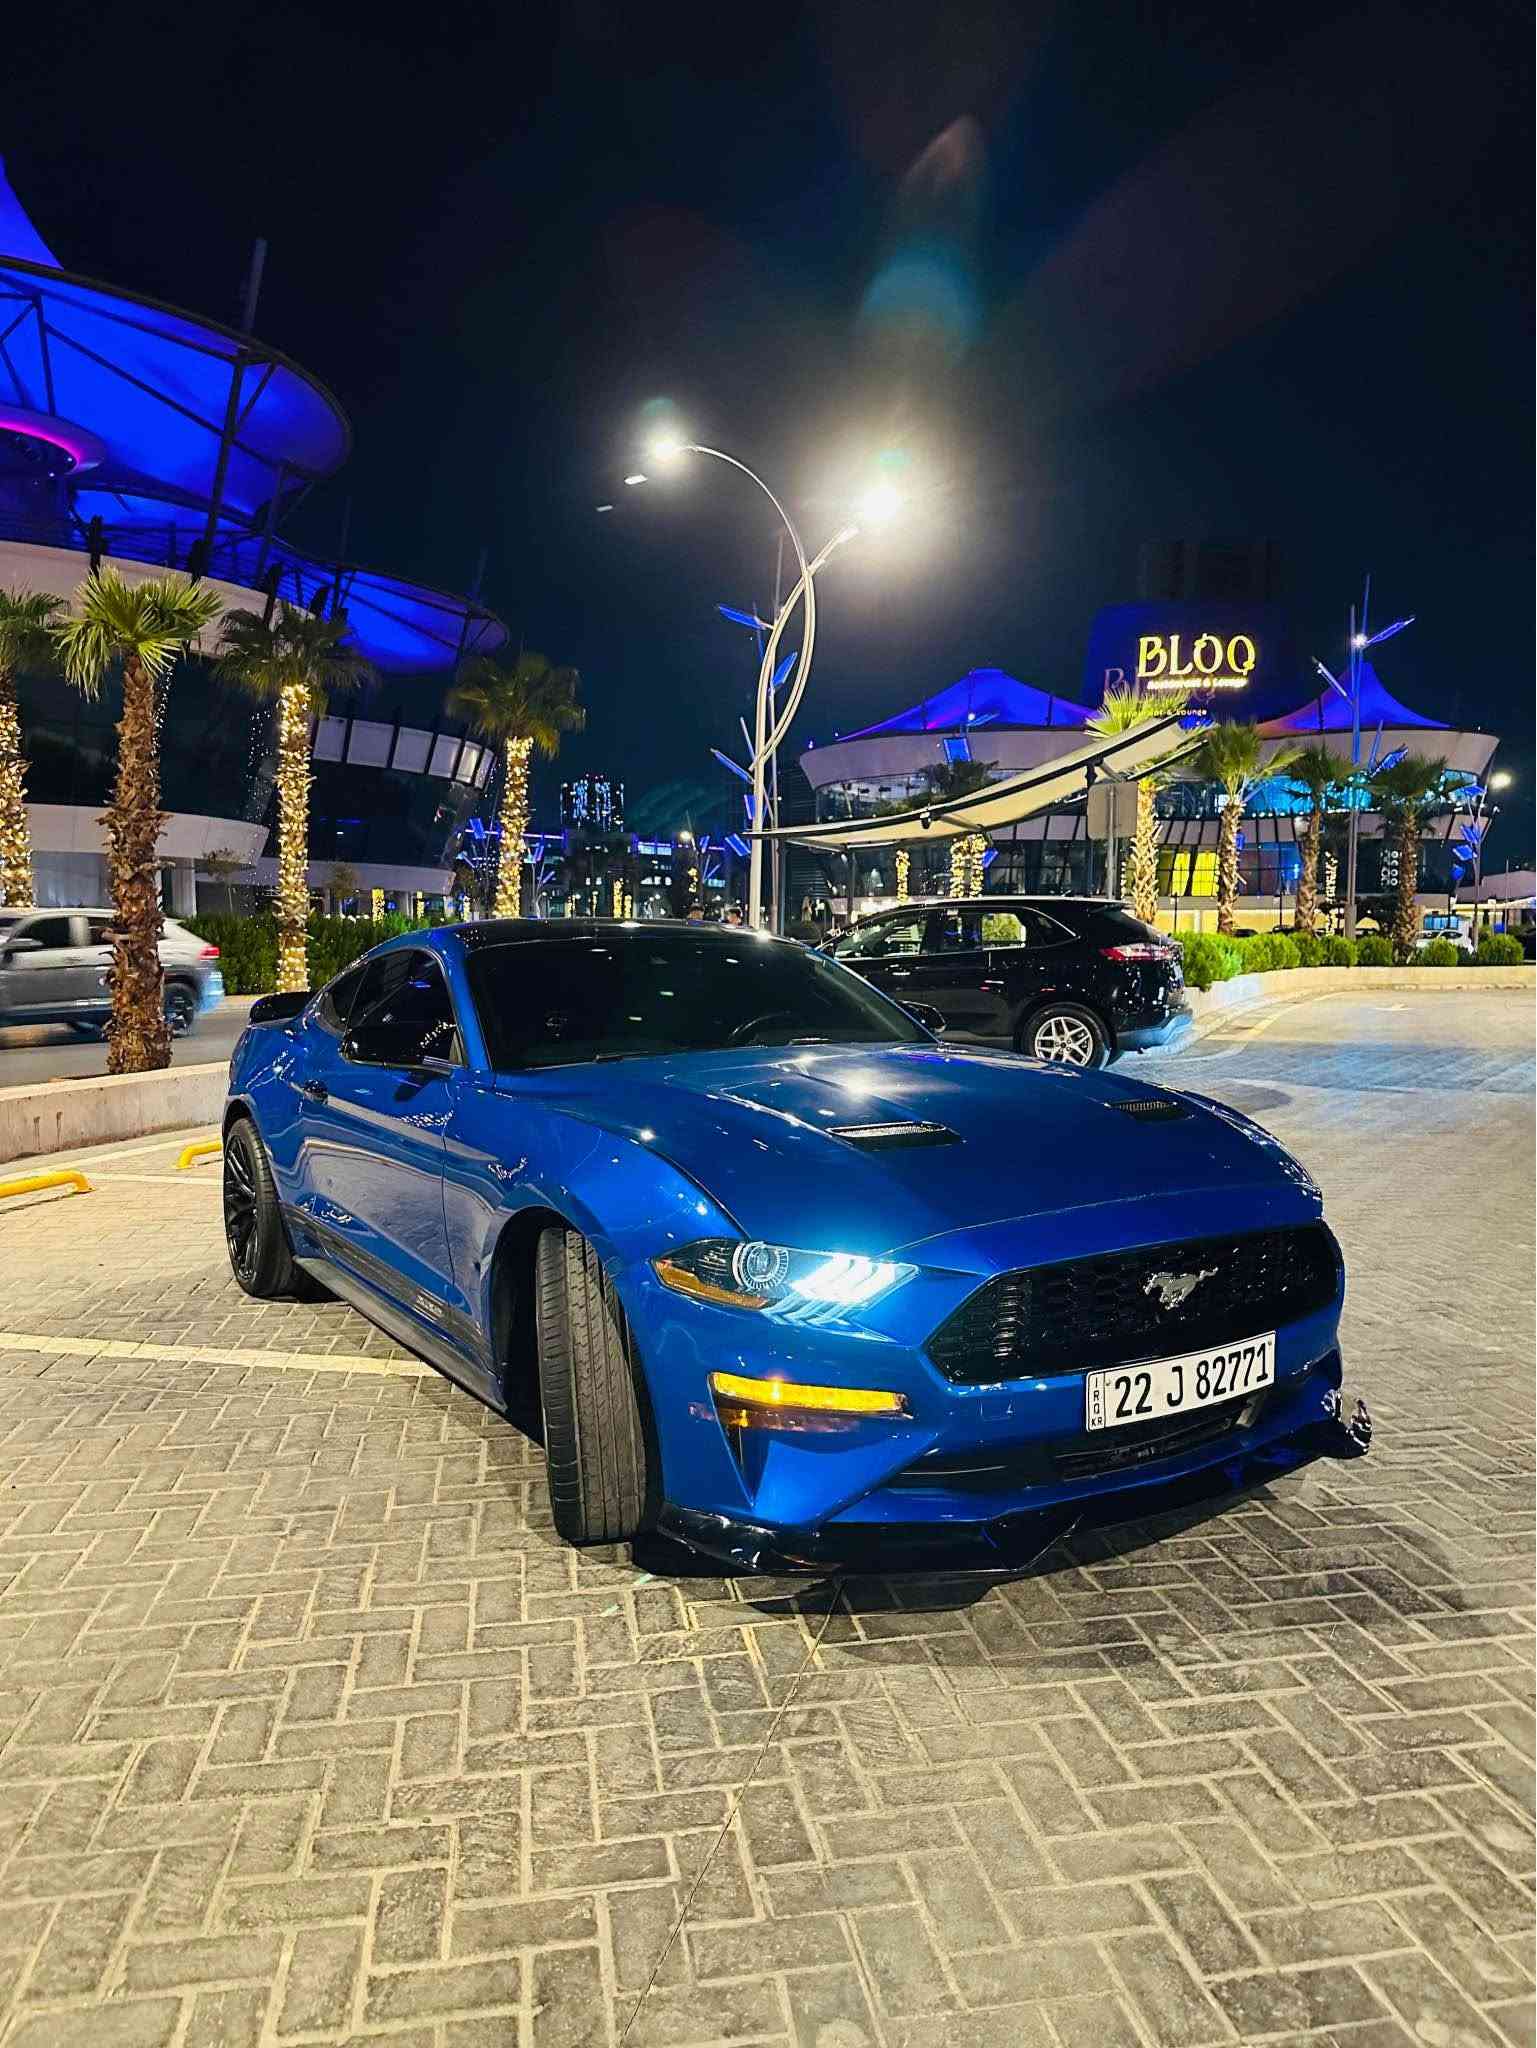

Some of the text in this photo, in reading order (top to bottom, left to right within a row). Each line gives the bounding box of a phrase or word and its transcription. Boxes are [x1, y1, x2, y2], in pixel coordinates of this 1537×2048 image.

[1137, 633, 1256, 677] BLOQ
[1114, 1343, 1269, 1418] 22 J 82771
